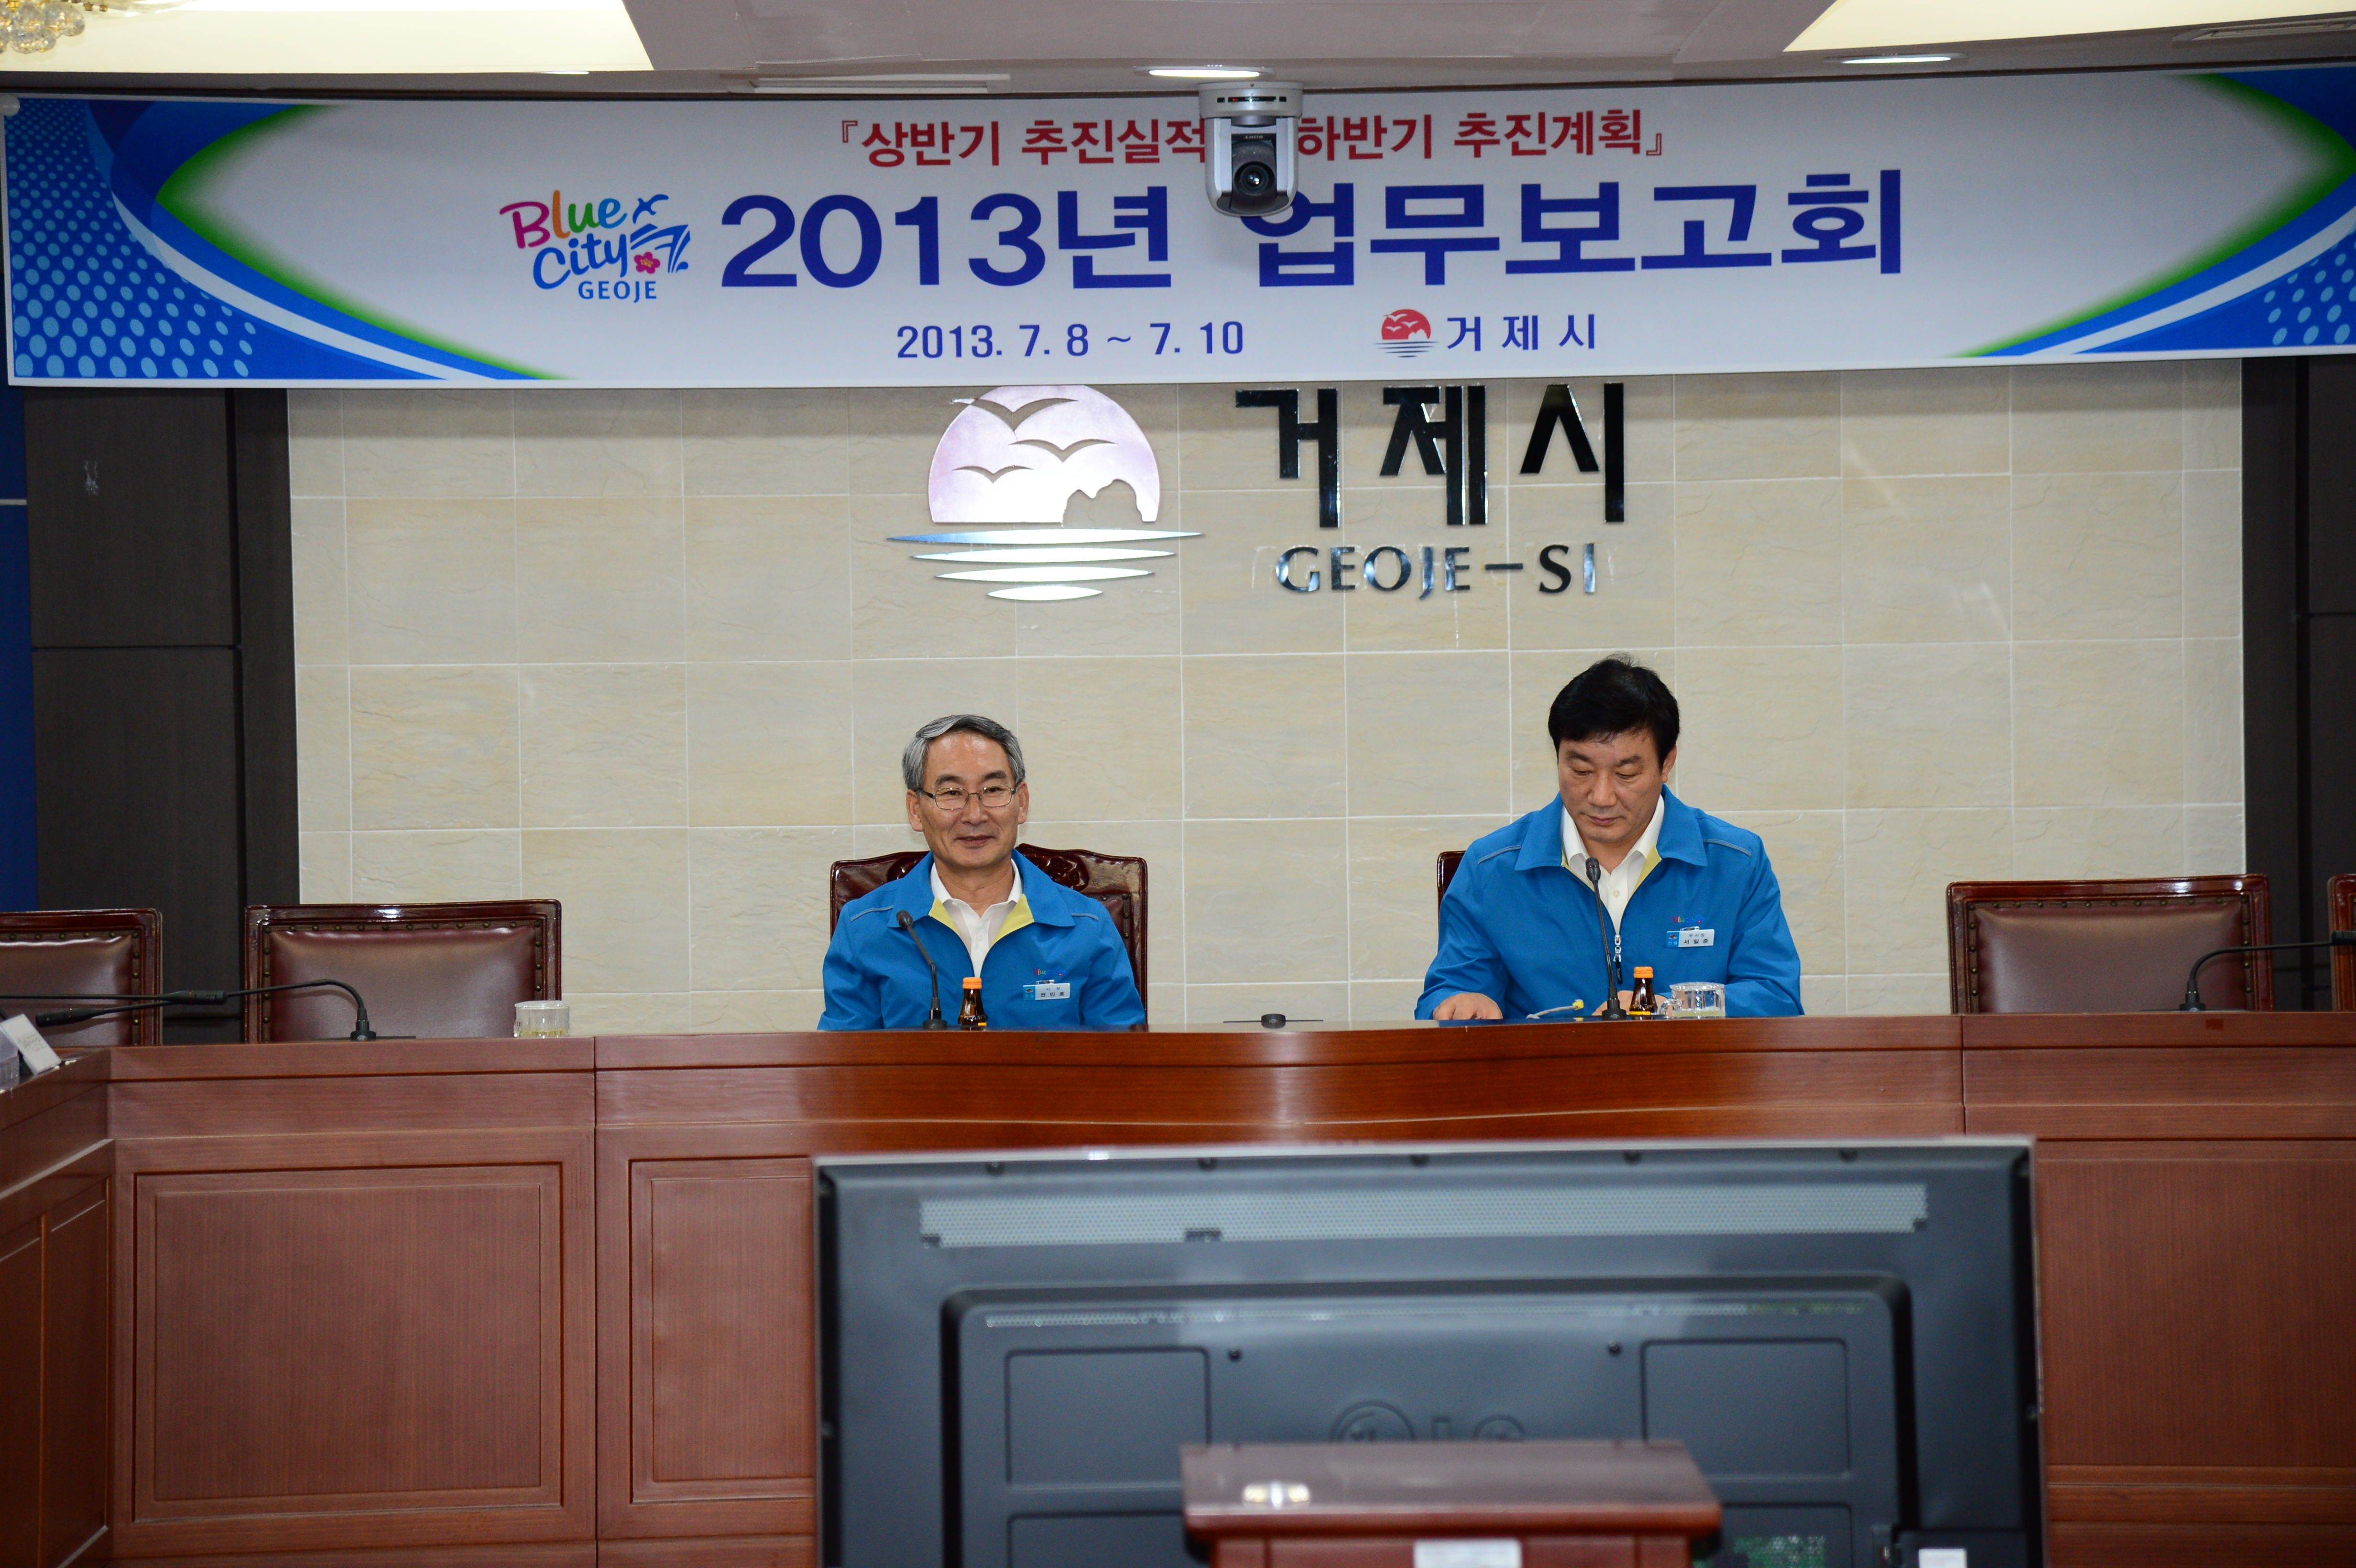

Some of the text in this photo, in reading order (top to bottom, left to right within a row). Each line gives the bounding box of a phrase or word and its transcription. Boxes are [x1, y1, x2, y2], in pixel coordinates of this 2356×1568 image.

[1022, 118, 1205, 165] 추진실적
[1298, 114, 1431, 161] 하반기
[499, 190, 627, 249] Blue
[721, 169, 1902, 290] 2013년 업무보고회
[533, 232, 627, 290] City
[578, 281, 657, 304] GEOJE
[1066, 323, 1090, 357] 8
[1200, 321, 1244, 355] 10
